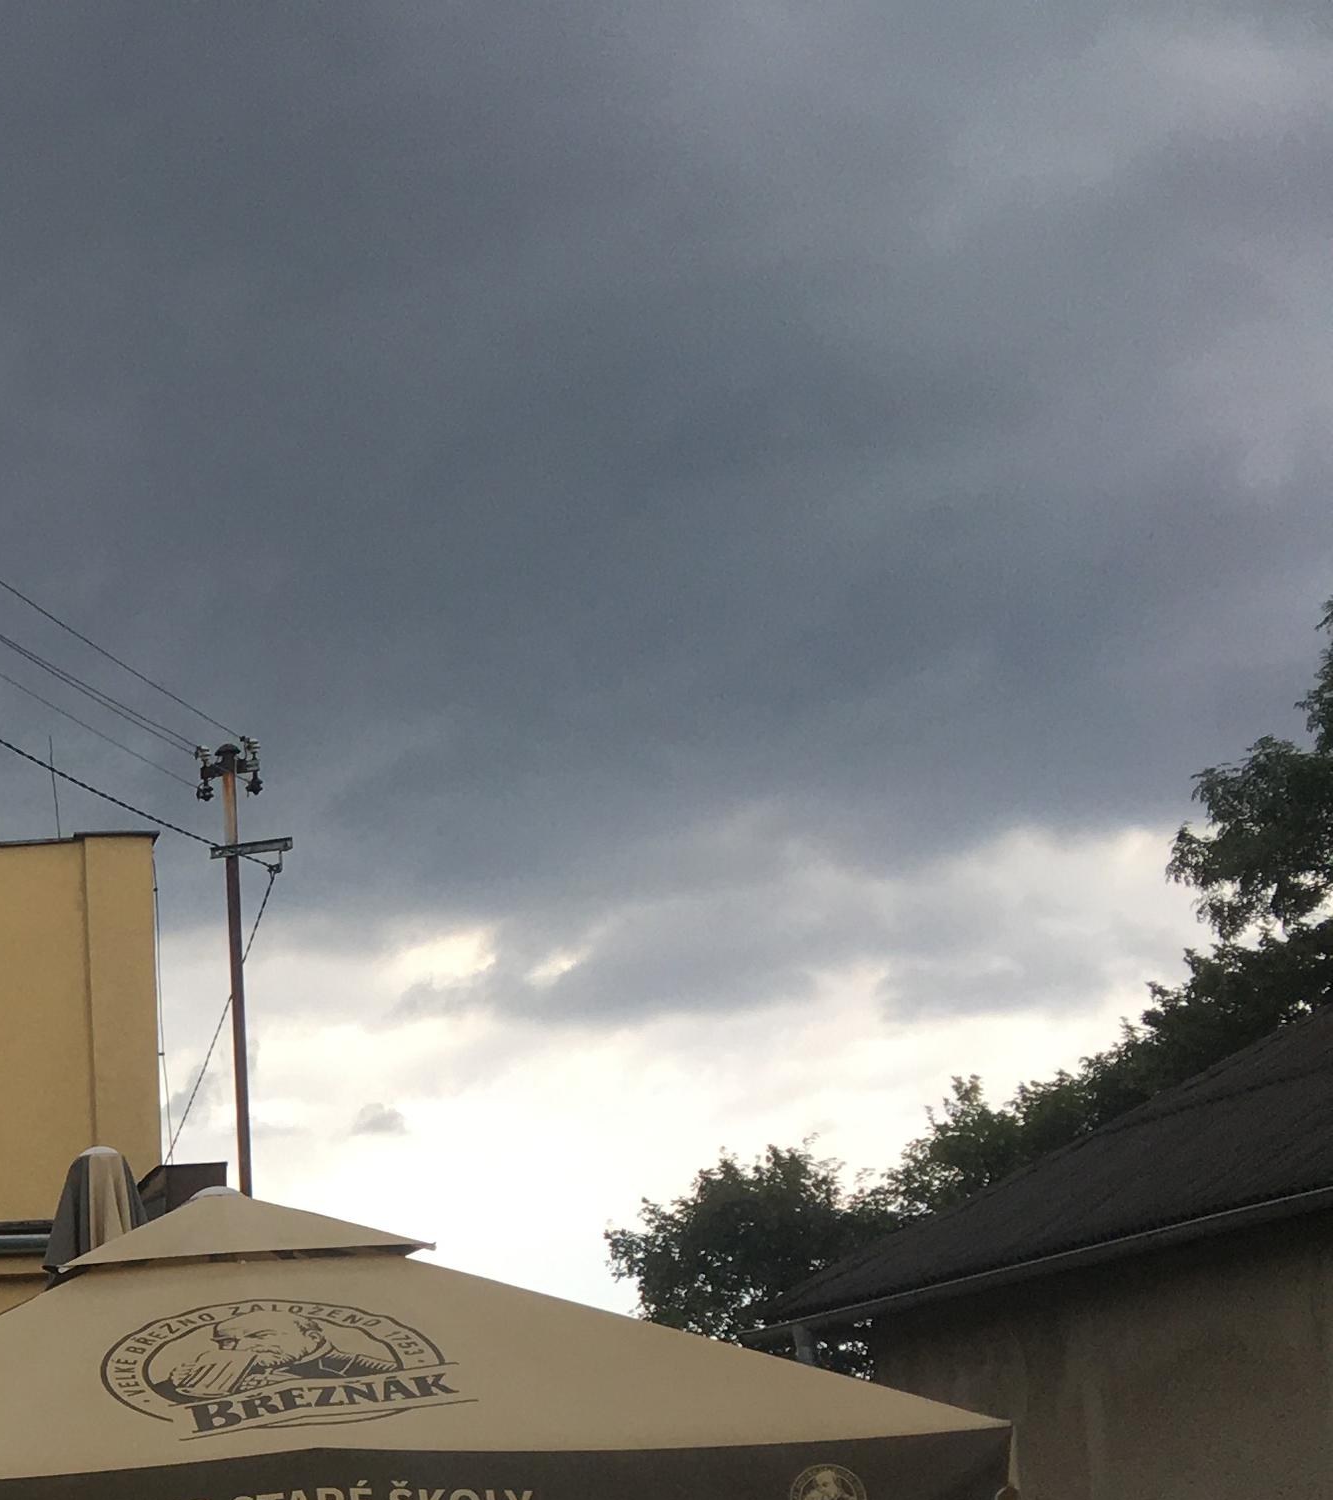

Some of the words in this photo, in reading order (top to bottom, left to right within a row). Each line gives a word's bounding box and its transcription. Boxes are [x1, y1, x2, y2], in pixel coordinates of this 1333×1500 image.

[125, 1312, 216, 1356] BŘEZNO
[228, 1303, 382, 1328] ZALOŽENO
[384, 1330, 425, 1357] 1753
[112, 1357, 146, 1398] VELKÉ
[184, 1372, 460, 1434] BŘEZŇÁK
